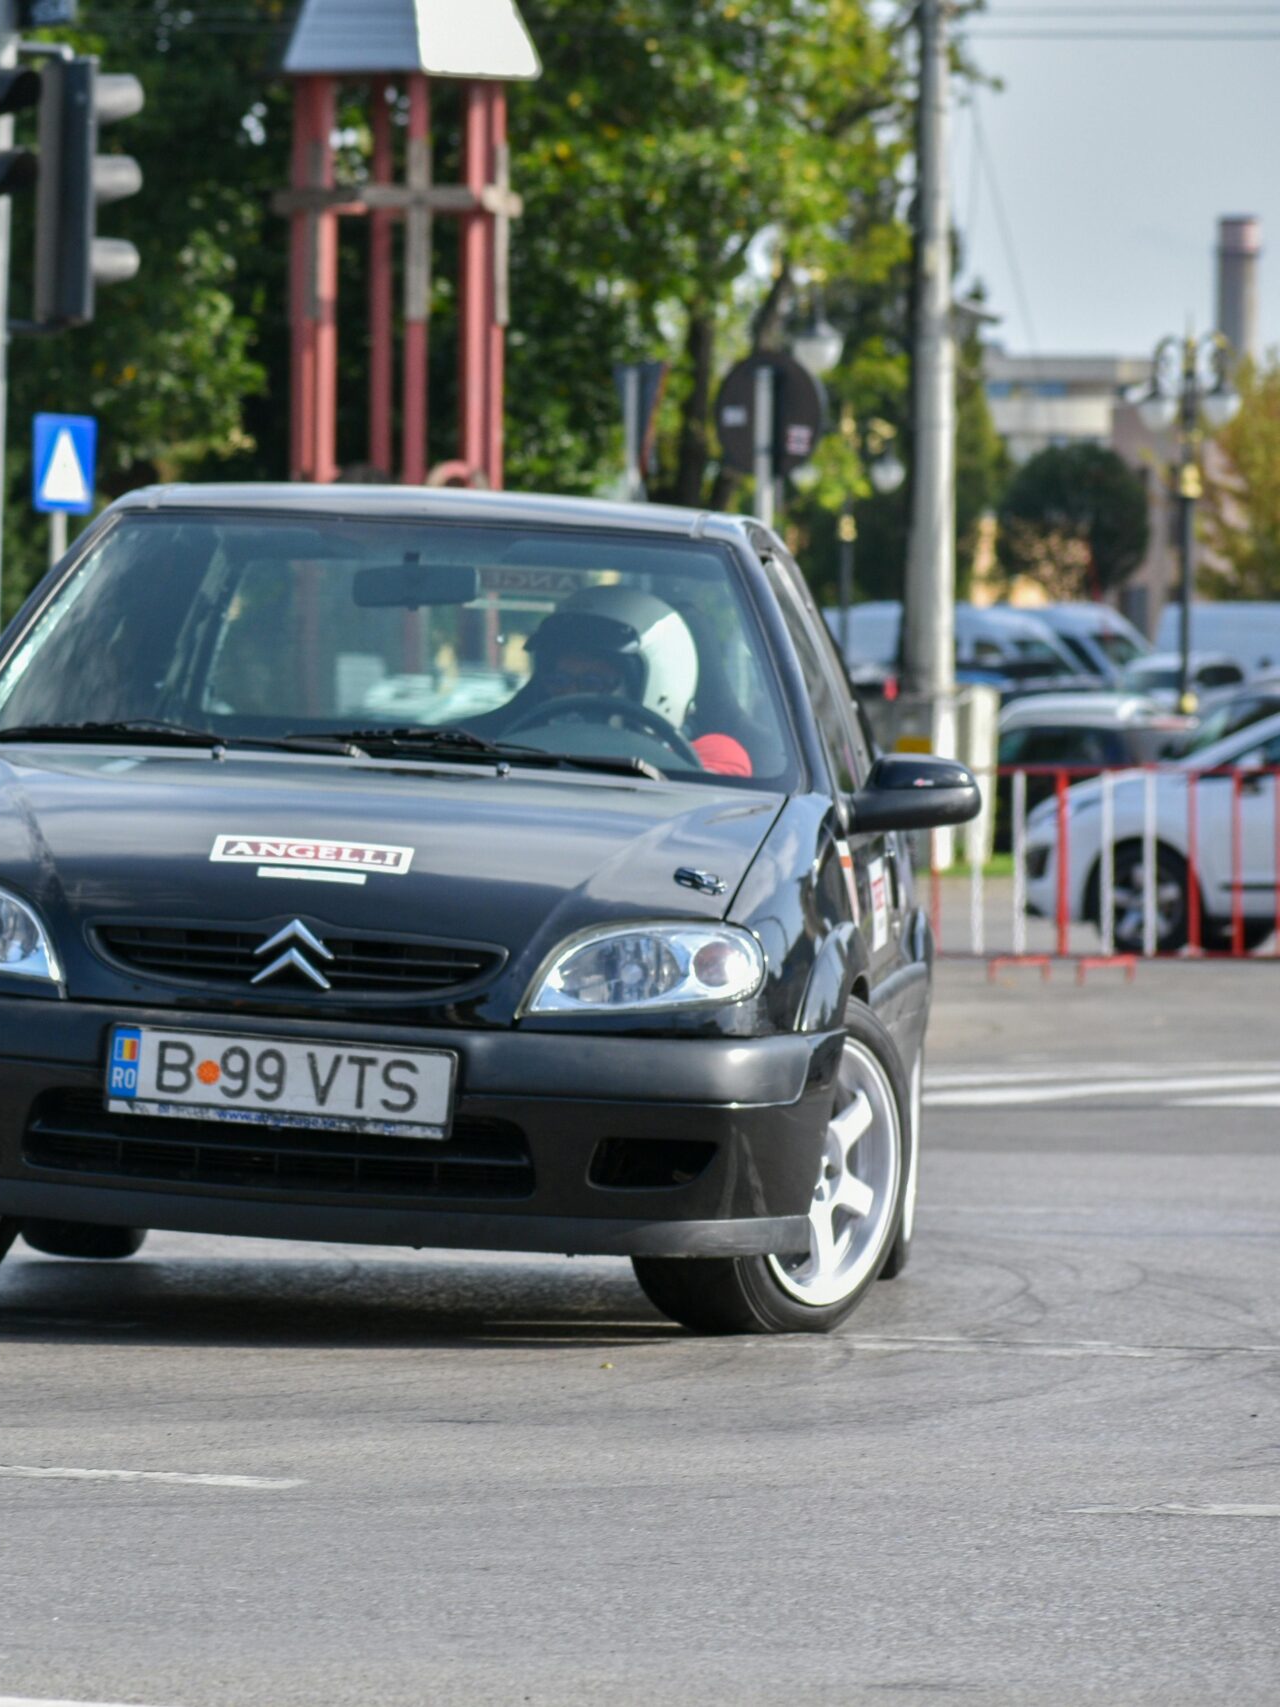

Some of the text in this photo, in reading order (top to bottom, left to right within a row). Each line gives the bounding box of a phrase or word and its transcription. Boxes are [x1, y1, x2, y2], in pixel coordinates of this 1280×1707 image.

[226, 841, 399, 867] ANGELLI
[111, 1066, 136, 1089] RO
[156, 1040, 420, 1113] B 99 VTS
